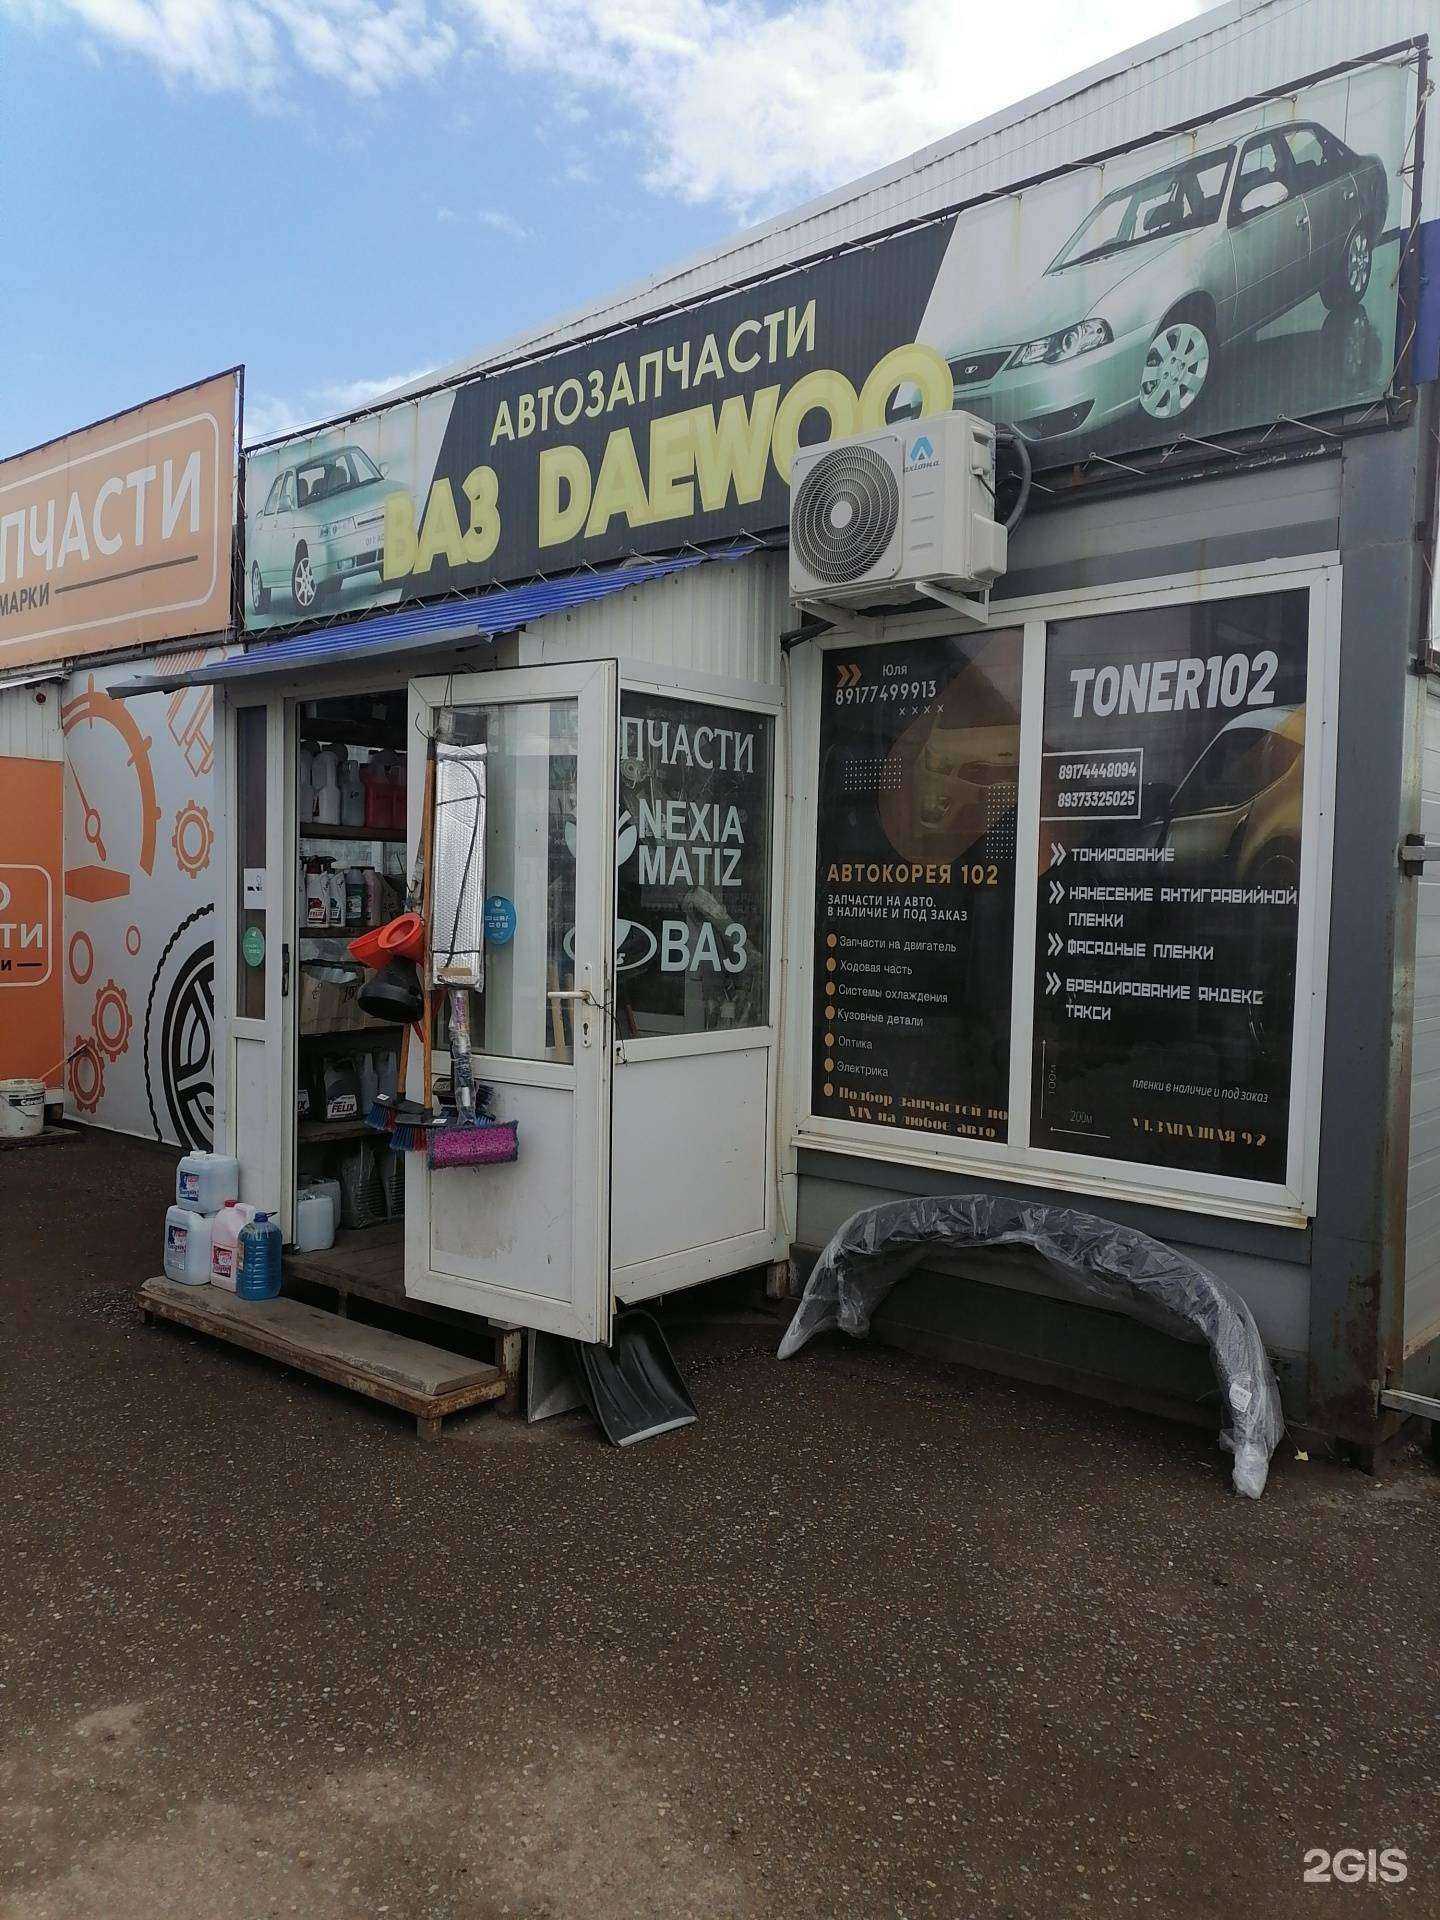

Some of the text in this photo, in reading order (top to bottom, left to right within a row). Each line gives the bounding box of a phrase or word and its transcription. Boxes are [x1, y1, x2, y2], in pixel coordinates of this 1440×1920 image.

[491, 299, 816, 446] АВТОЗАПЧАСТИ
[383, 342, 954, 581] ВАЗ DAEWOO
[0, 451, 200, 583] ПЧАСТИ
[0, 582, 49, 616] МАРКИ
[882, 664, 908, 677] Юля
[835, 680, 937, 706] 89177499913
[1070, 650, 1279, 718] TONER102
[621, 716, 754, 773] ПЧАСТИ
[1059, 762, 1137, 779] 89174448094
[1057, 790, 1136, 808] 89373325025
[639, 799, 744, 844] NEXIA
[1071, 847, 1175, 862] ТОНИРОВАНИЕ
[638, 845, 742, 887] MATIZ
[827, 863, 998, 885] АВТОКОРЕЯ 102
[827, 894, 882, 906] ЗАПЧАСТИ
[886, 896, 901, 906] НА
[1069, 886, 1297, 905] НАНЕСЕНИЕ АНТИГРАВИЙНОЙ
[827, 906, 968, 922] В НАЛИЧИЕ И ПОД ЗАКАЗ
[1068, 912, 1124, 928] ПЛЕНКИ
[660, 919, 748, 974] ВАЗ
[839, 935, 957, 953] Запчасти на двигатель
[1067, 939, 1214, 960] ФАСАДНЫЕ ПЛЕНКИ
[840, 959, 913, 975] Ходовая часть
[838, 984, 948, 1004] Системы охлаждения
[1066, 978, 1264, 1005] БРЕНДИРОВАНИЕ ЯНДЕКС
[837, 1008, 924, 1027] Кузовные детали
[1066, 1004, 1112, 1021] ТАКСИ
[838, 1035, 873, 1050] Оптика
[836, 1060, 889, 1078] Электрика
[1132, 1079, 1269, 1103] пленки в наличие и под заказ
[332, 1102, 355, 1113] FELIX
